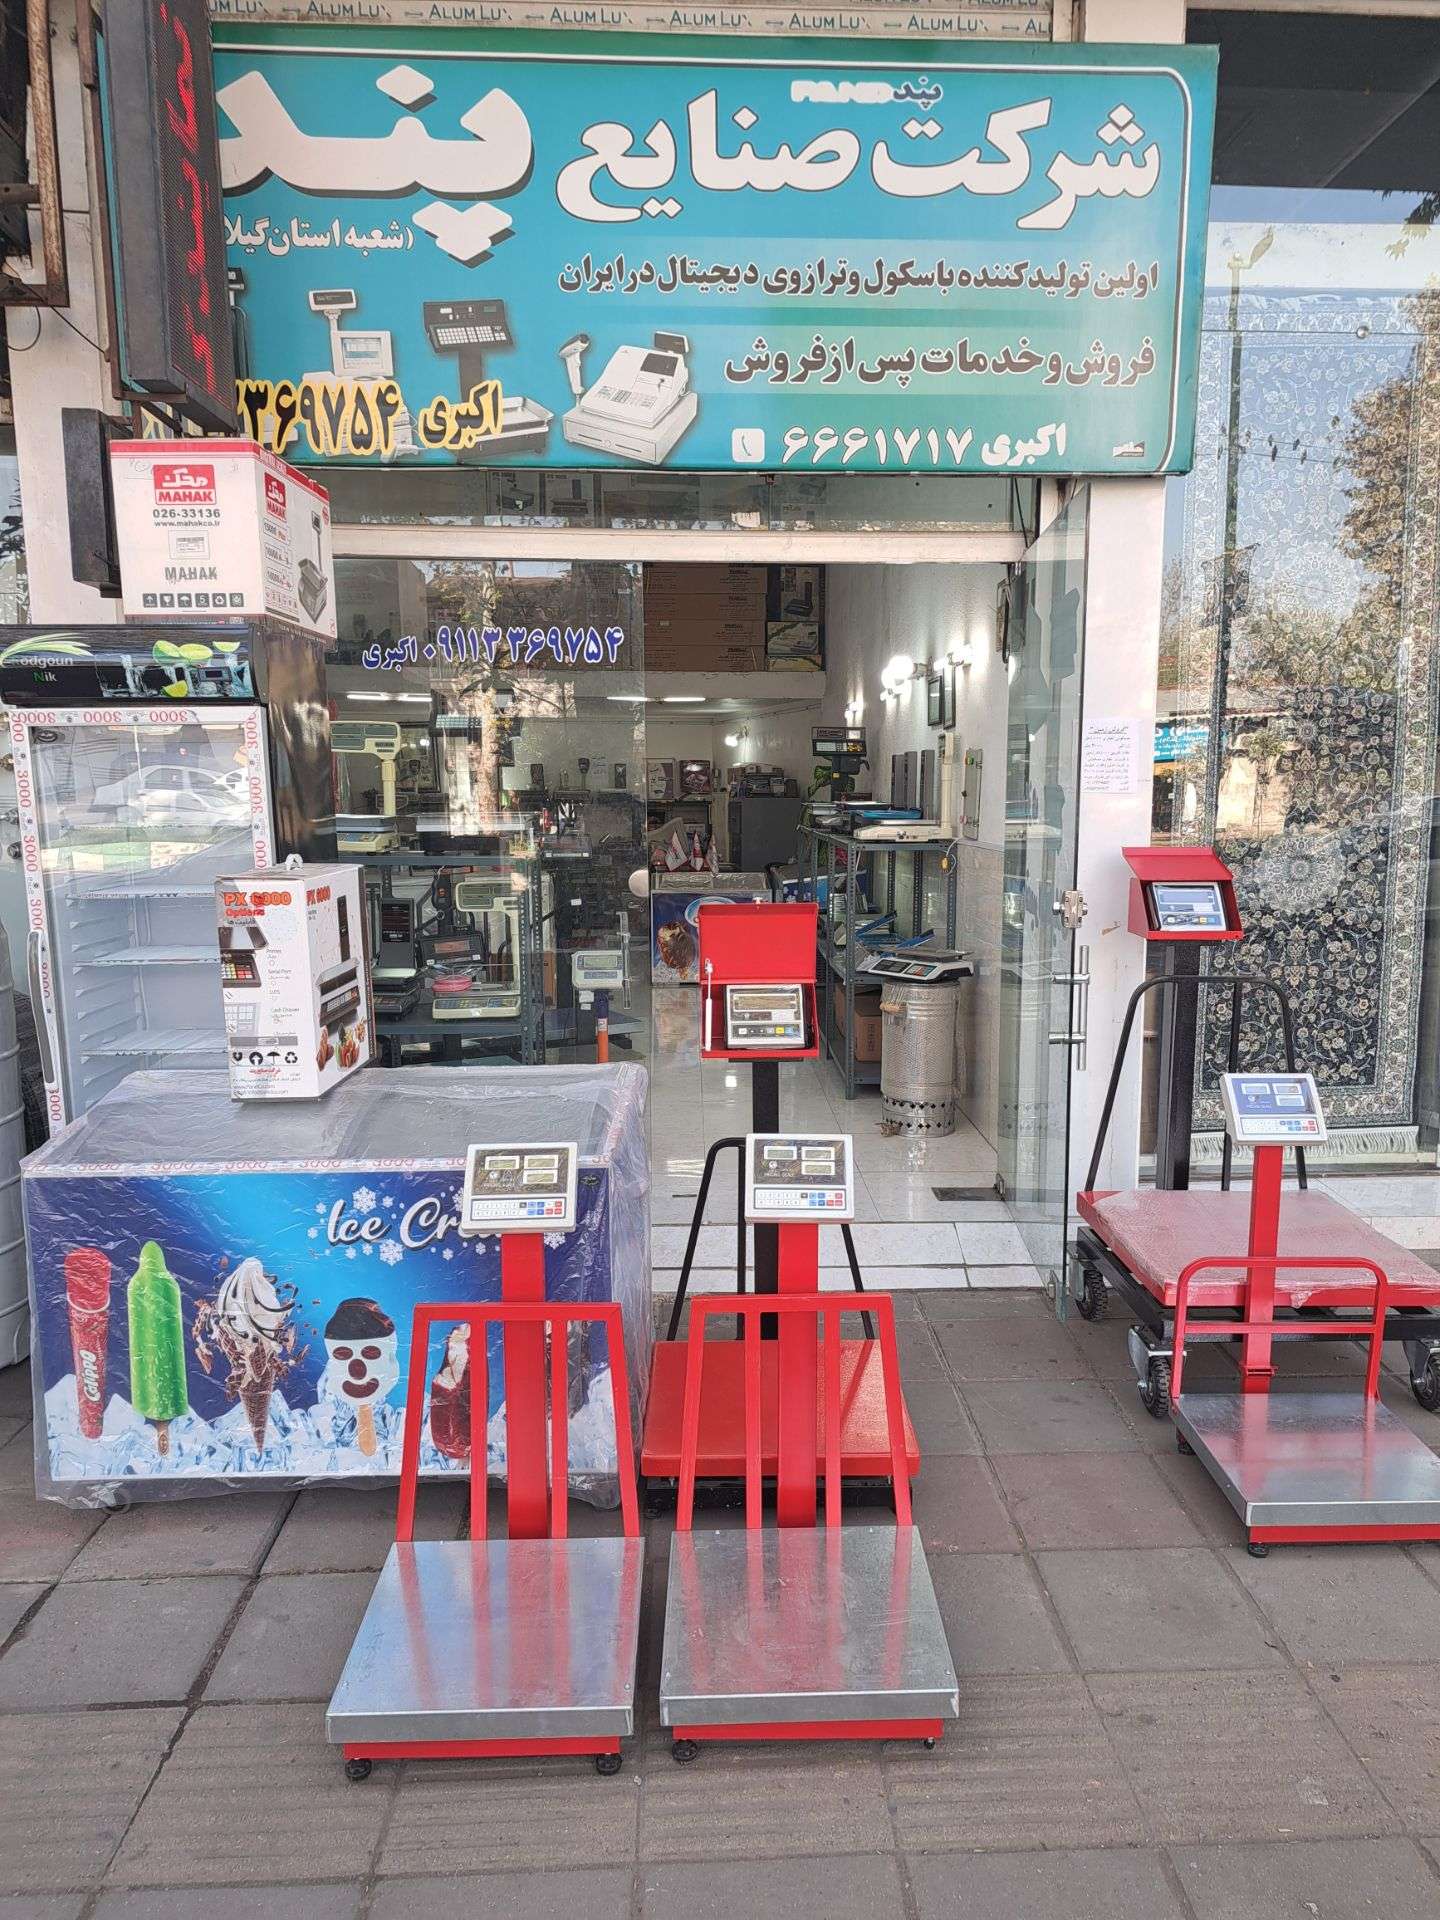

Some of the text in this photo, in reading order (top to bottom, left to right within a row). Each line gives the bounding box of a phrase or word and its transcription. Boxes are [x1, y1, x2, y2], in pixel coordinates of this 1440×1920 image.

[216, 64, 1162, 264] شرکت صنایع پند
[223, 214, 271, 254] گیلا
[267, 216, 342, 257] استان
[657, 253, 760, 294] دیجیتال
[863, 257, 955, 297] باسکول
[1093, 260, 1159, 299] اولین
[857, 347, 917, 389] پس
[417, 378, 504, 451] اکبری
[781, 421, 1067, 467] اکبری ۶۶۶۱۷۱۷
[152, 508, 221, 519] 026-33136
[158, 490, 213, 503] MAHAK
[164, 566, 218, 581] MAHAK
[361, 635, 417, 672] اکبری
[33, 671, 58, 682] Nik
[326, 1198, 391, 1246] Ice
